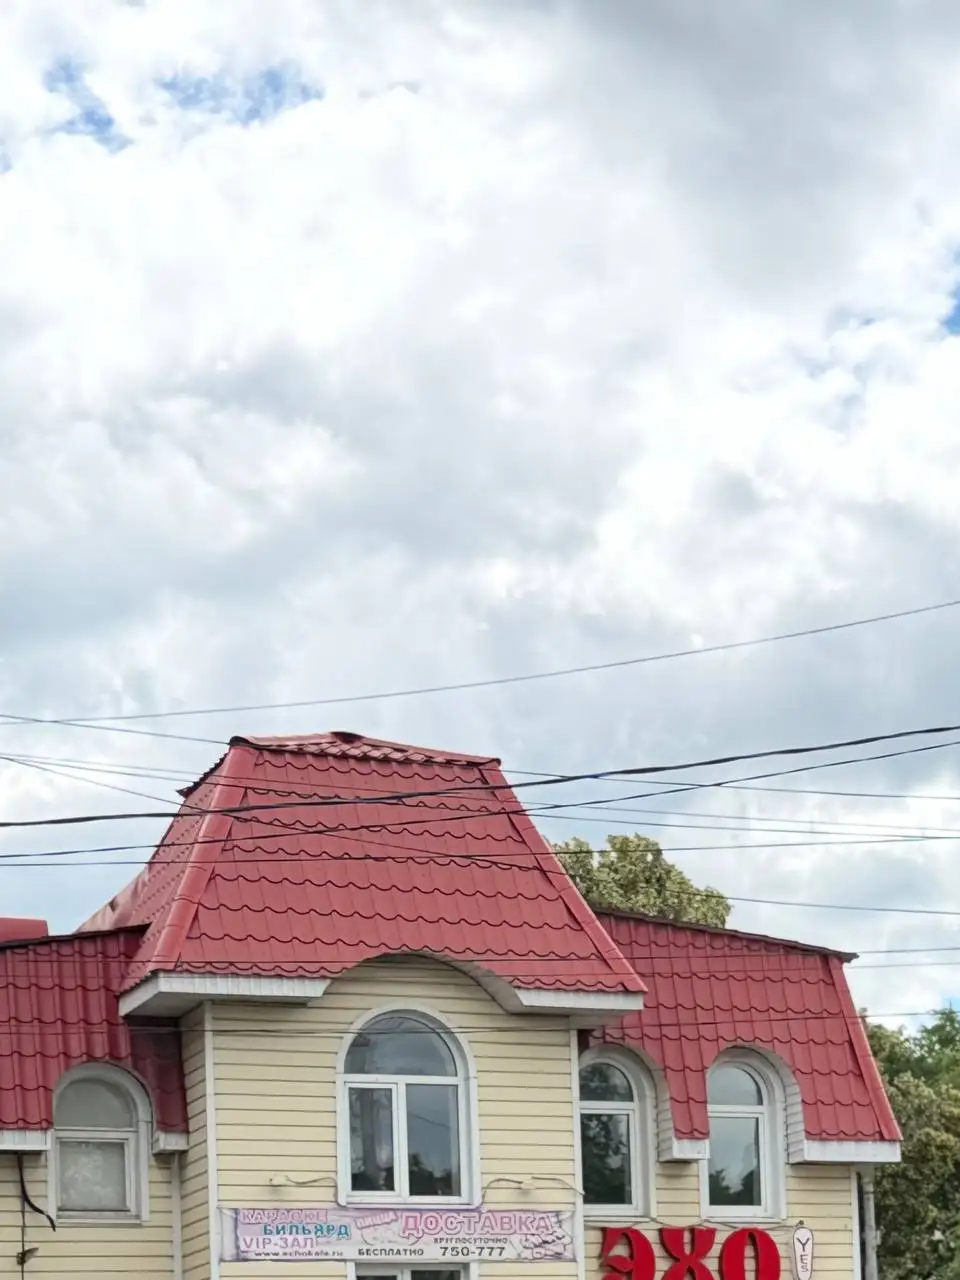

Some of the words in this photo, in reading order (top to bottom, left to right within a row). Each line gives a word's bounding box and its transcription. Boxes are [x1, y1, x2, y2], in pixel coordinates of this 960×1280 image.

[402, 1213, 552, 1236] ДОСТАВКА
[263, 1224, 350, 1239] БИЛЬЯРД
[243, 1237, 314, 1250] VIP-ЗАЛ
[358, 1248, 424, 1257] БЕСПЛАТНО
[439, 1246, 506, 1257] 750-777
